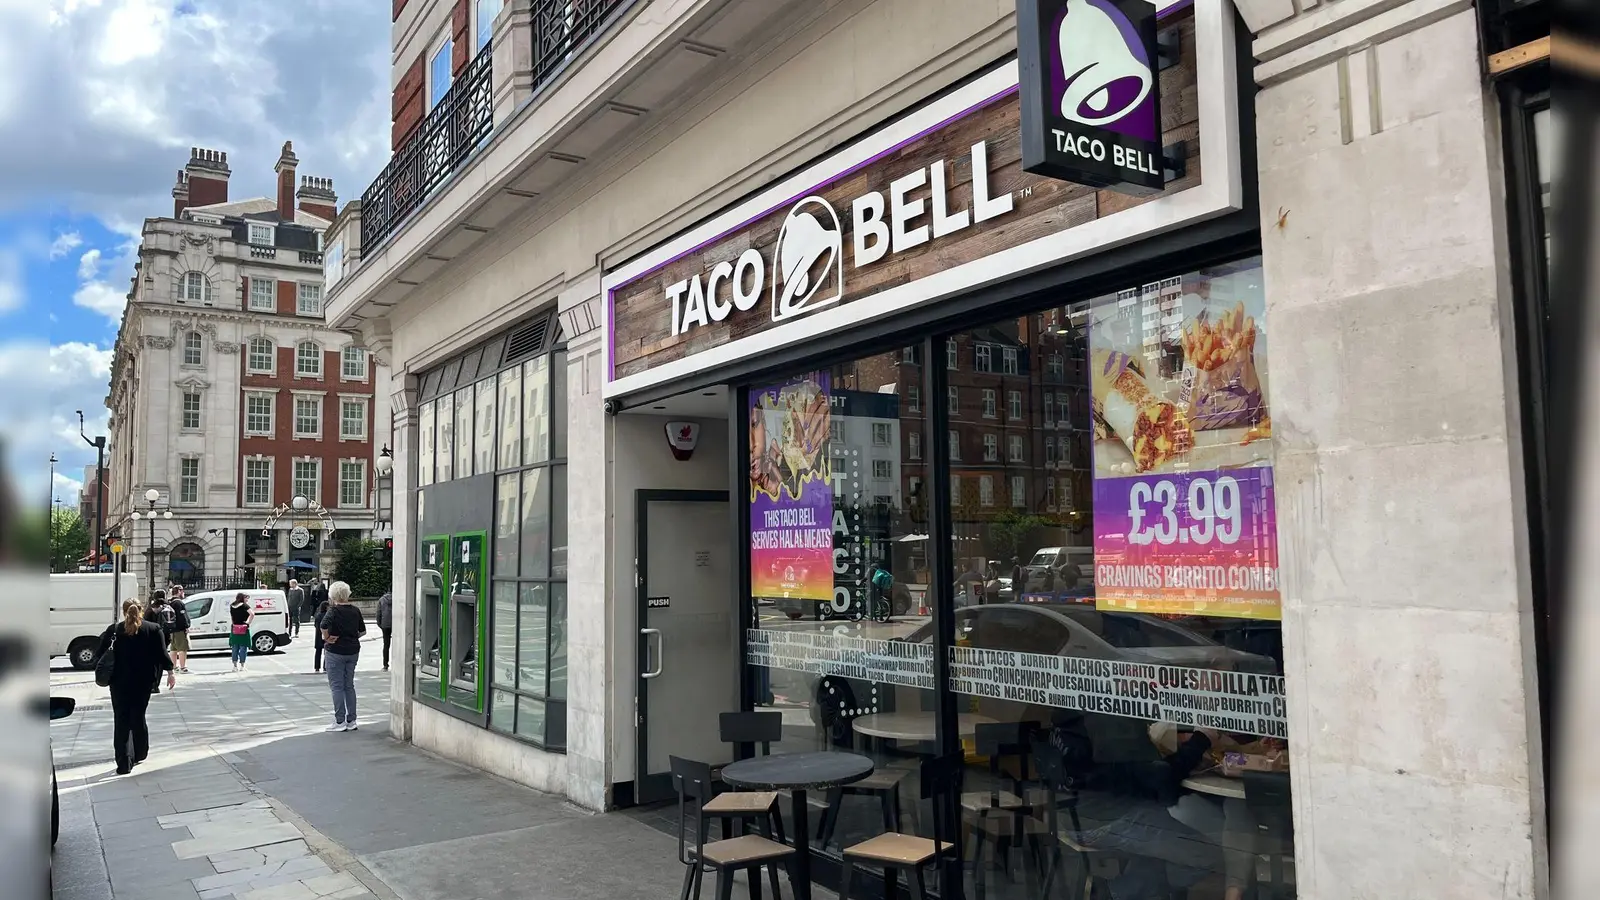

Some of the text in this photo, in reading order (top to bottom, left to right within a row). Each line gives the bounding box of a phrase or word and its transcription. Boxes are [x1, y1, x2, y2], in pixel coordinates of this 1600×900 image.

[1052, 128, 1159, 175] TACO BELL
[665, 248, 764, 337] TACO
[852, 140, 1013, 268] BELL
[261, 499, 336, 538] PIZZA PIZZA
[764, 507, 817, 528] THIS TACO BELL
[1128, 476, 1242, 545] £3.99
[752, 528, 831, 549] SERVES HALAL MEATS
[1097, 564, 1162, 588] CRAVINGS
[1164, 564, 1226, 590] BURRITO
[648, 598, 669, 607] PUSH
[812, 635, 840, 650] NACHOS
[865, 639, 919, 660] QUESADILLA
[841, 649, 866, 666] TACOS
[899, 660, 924, 673] BURRITO
[821, 661, 868, 679] QUESADILLA
[868, 670, 885, 682] TACOS
[885, 673, 917, 686] QUESADILLA
[949, 647, 985, 667] ADILLA
[986, 652, 1016, 667] TACOS
[1020, 653, 1060, 670] BURRITO
[1063, 657, 1111, 678] NACHOS
[1111, 662, 1155, 679] BURRITO
[1158, 666, 1259, 697] QUESADILLA
[961, 666, 993, 681] BURRITO
[992, 668, 1052, 690] CRUNCHWRAP
[1052, 676, 1113, 696] QUESADILLA
[1112, 678, 1159, 701] TACOS
[1159, 691, 1220, 712] CRUNCHWRAP
[1221, 697, 1272, 717] BURRITO
[974, 681, 1001, 698] TACOS
[1004, 685, 1046, 704] NACHOS
[1048, 692, 1076, 709] BURRITO
[1077, 693, 1162, 720] QUESADILLA
[1163, 708, 1194, 724] TACOS
[1196, 713, 1256, 733] QUESADILLA
